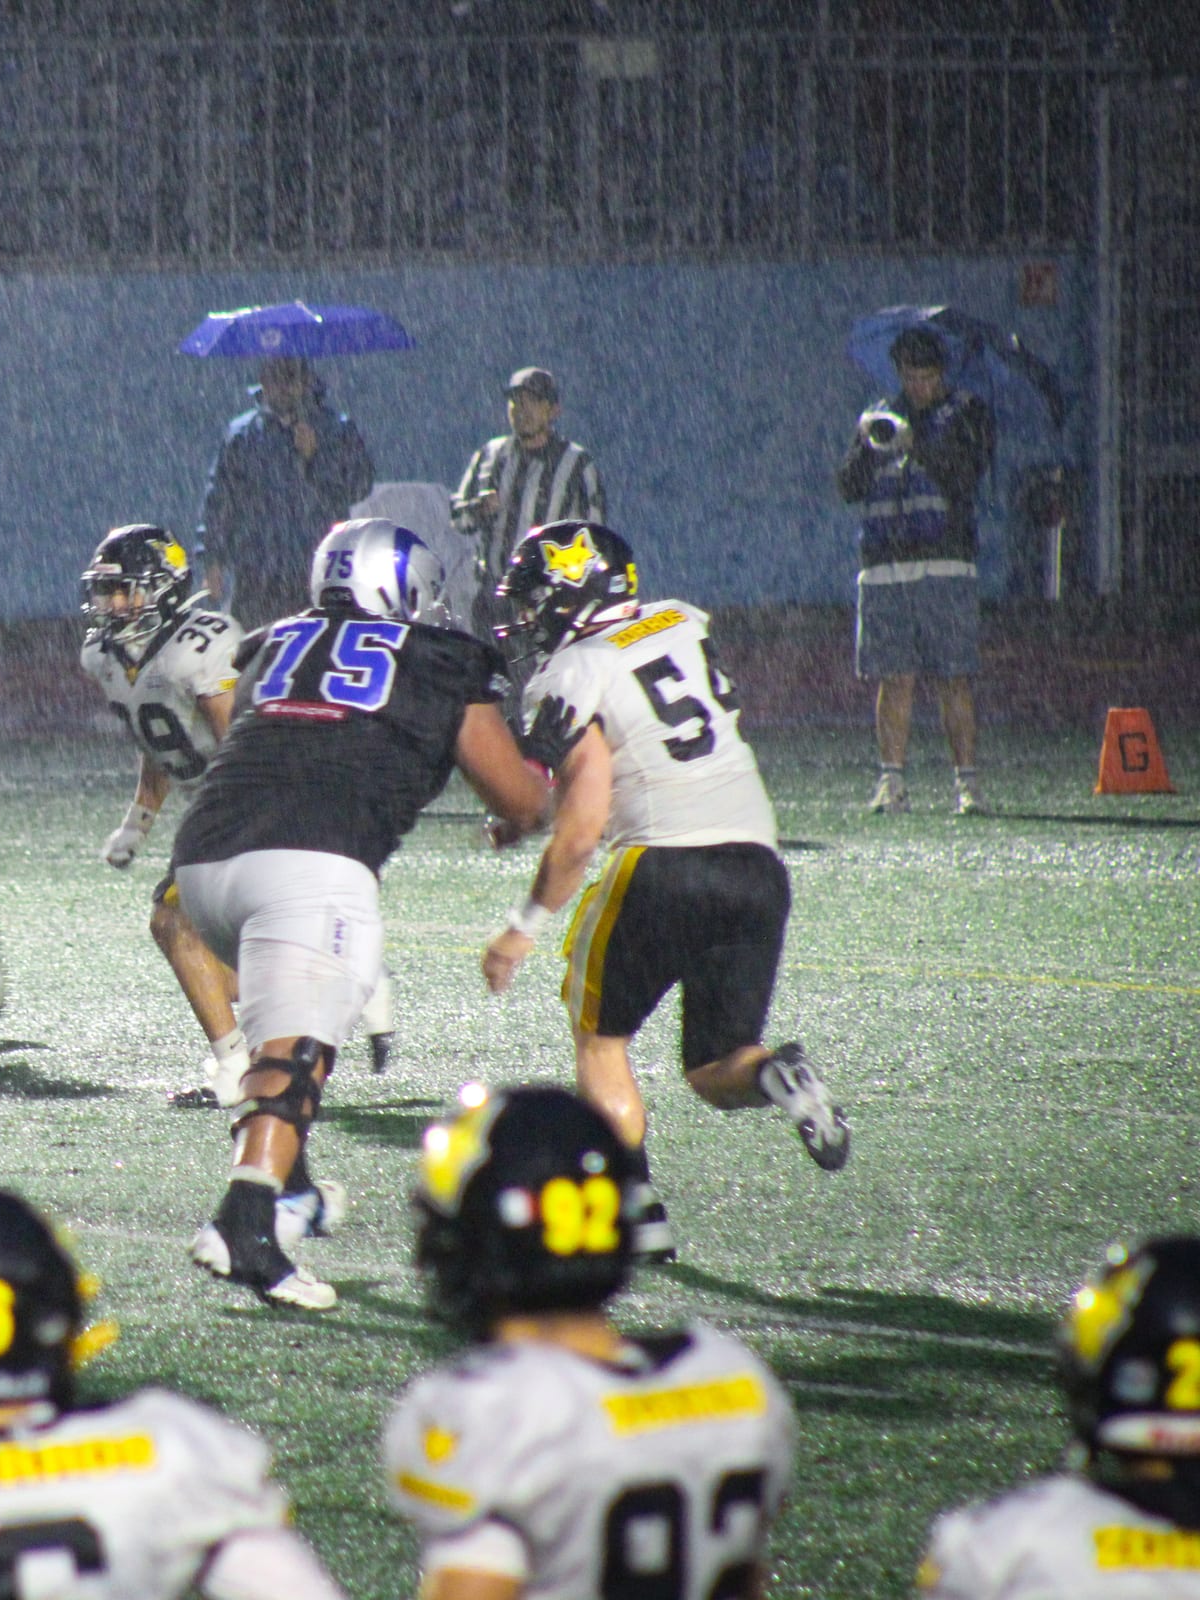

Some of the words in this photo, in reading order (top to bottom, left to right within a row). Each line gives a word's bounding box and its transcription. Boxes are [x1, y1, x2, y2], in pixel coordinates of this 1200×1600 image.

[324, 550, 353, 579] 75
[252, 617, 411, 712] 75
[1118, 732, 1150, 772] G
